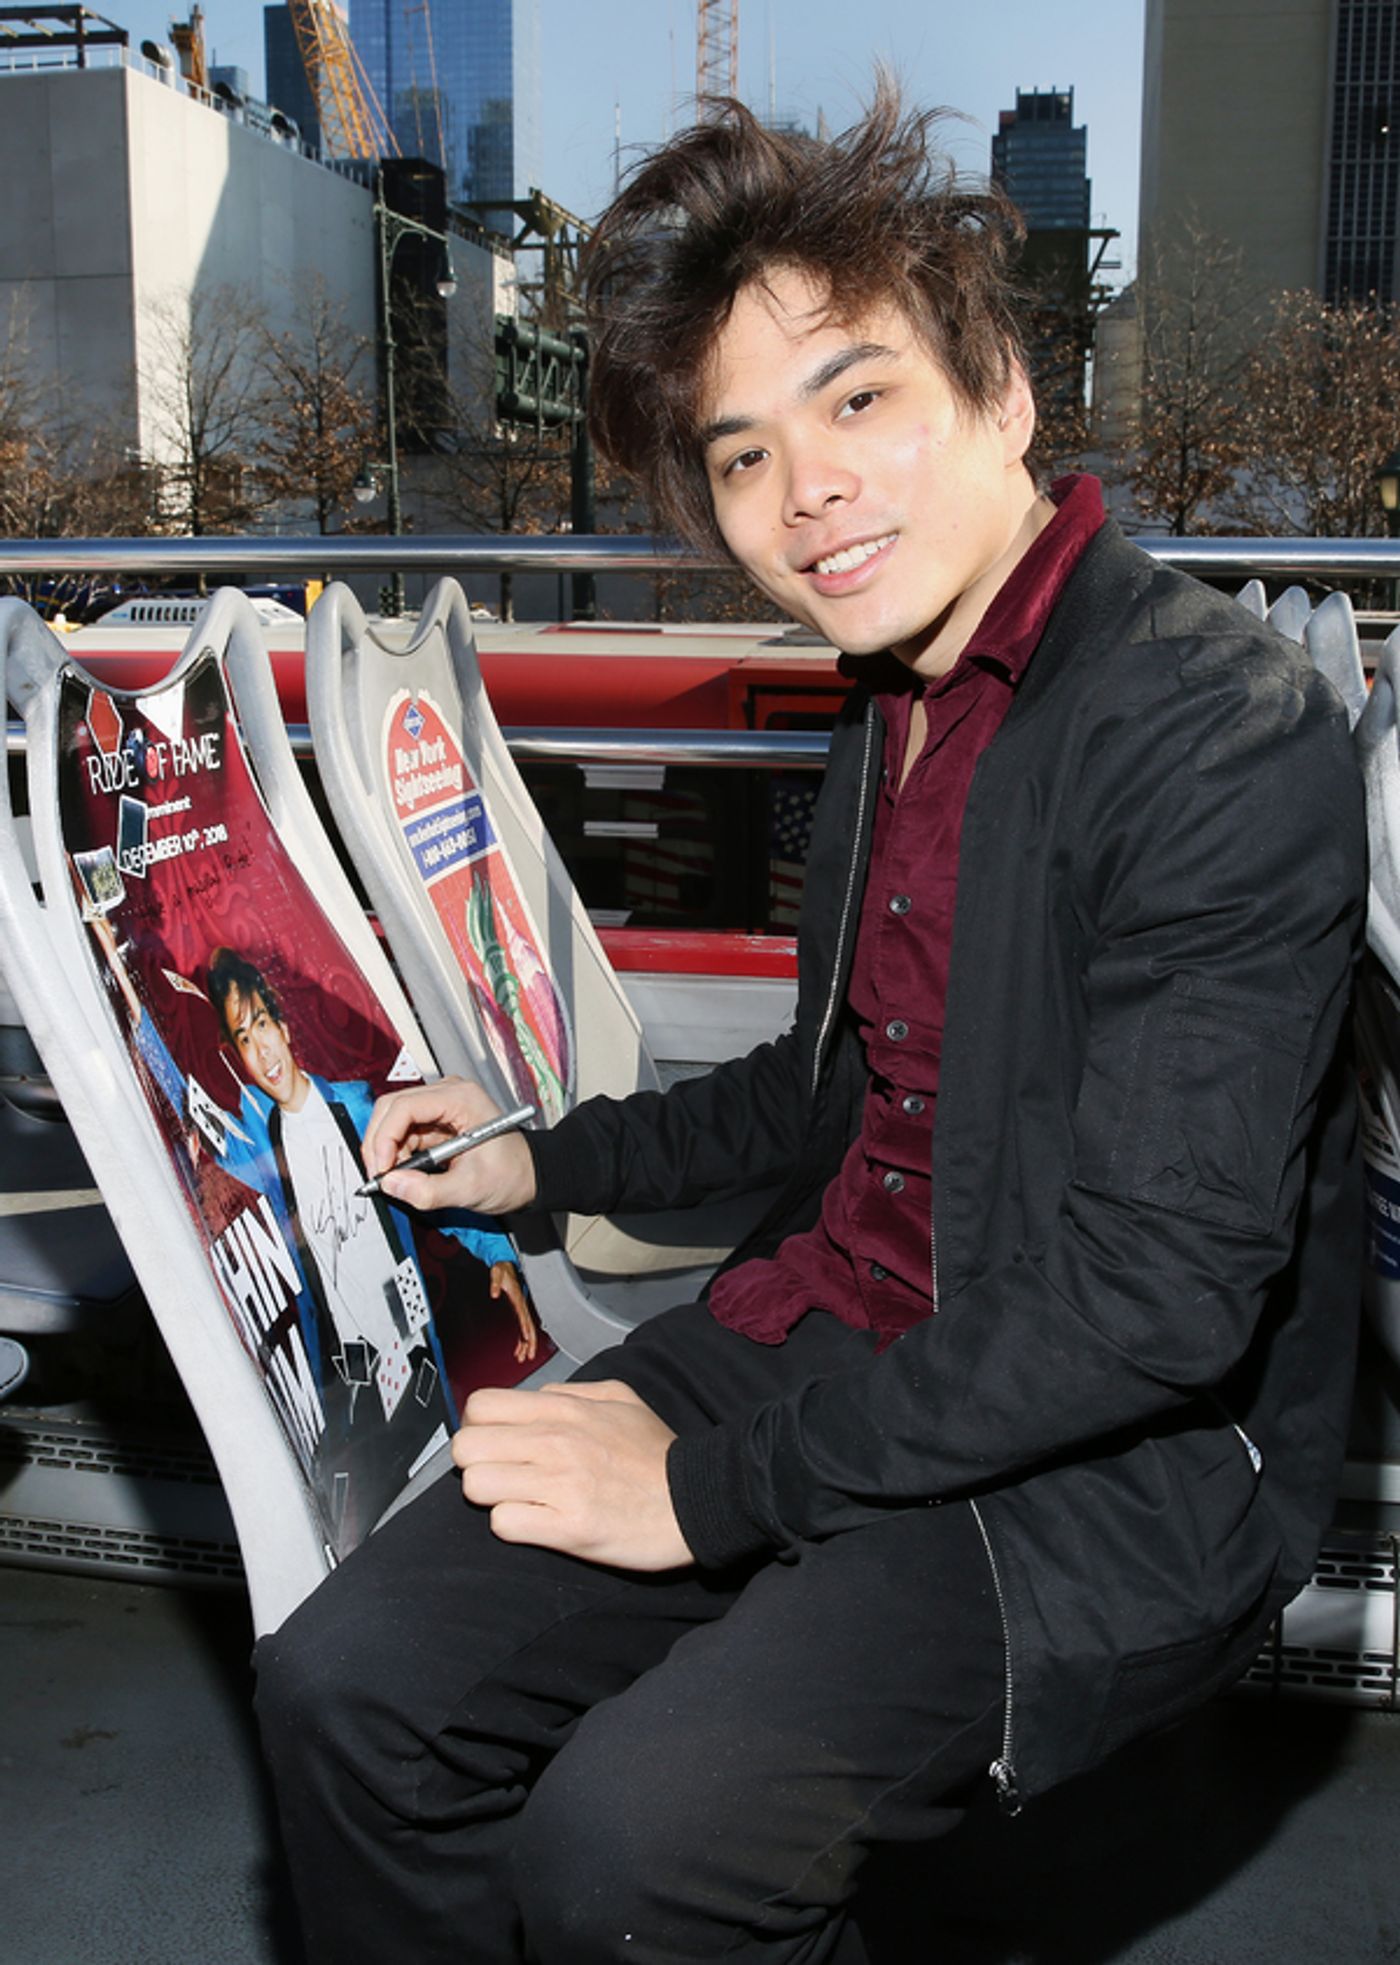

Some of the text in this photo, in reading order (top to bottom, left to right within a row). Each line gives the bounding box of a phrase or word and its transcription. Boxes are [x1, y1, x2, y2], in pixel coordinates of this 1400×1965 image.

[87, 749, 139, 795] RIDE
[170, 732, 221, 777] FAME
[395, 735, 447, 775] New York
[394, 763, 463, 810] Sightseeing
[121, 834, 183, 870] DECEMBER
